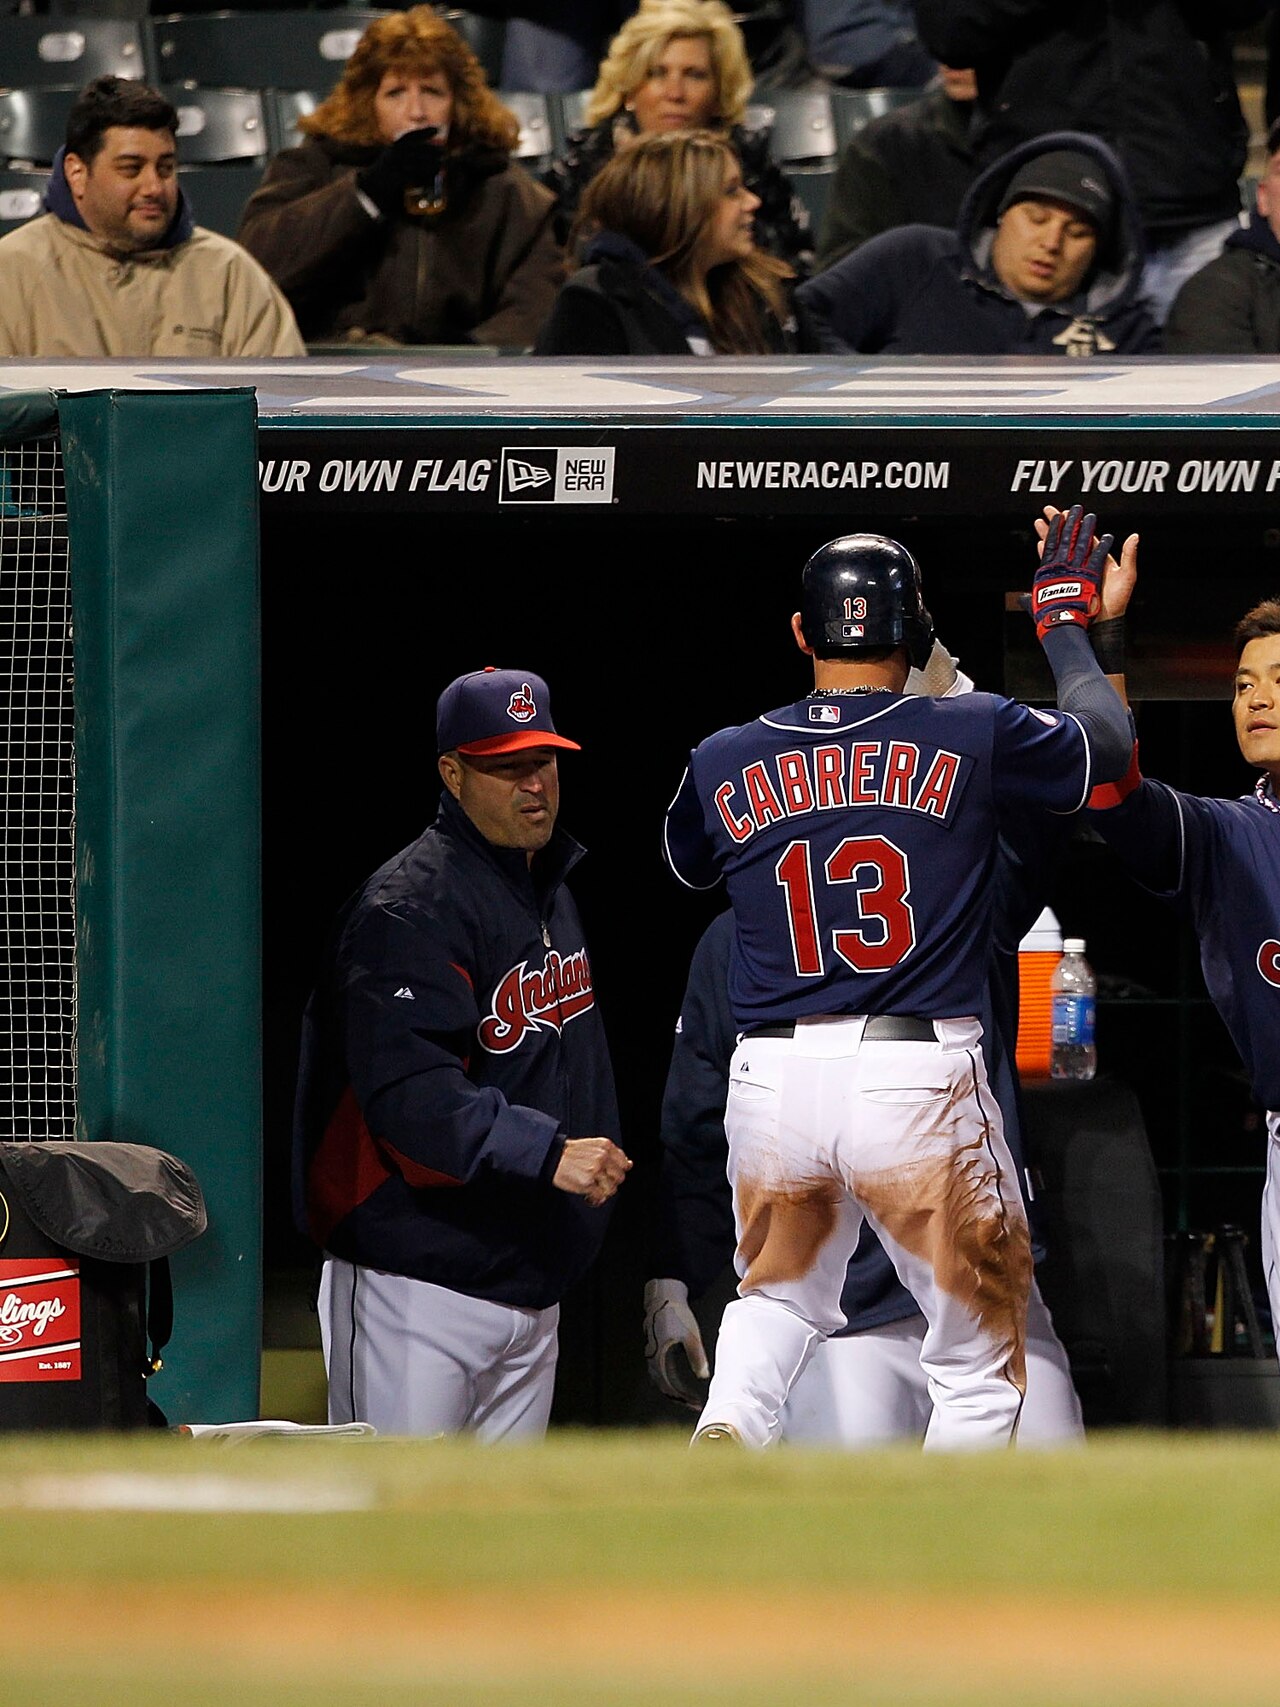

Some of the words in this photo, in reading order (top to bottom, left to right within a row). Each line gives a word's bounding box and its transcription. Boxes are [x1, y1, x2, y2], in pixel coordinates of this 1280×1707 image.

[259, 460, 310, 492] UR
[319, 459, 403, 492] OWN
[409, 460, 492, 492] FLAG
[564, 475, 605, 491] ERA
[565, 459, 606, 474] NEW
[697, 461, 949, 489] NEWERACAP.COM
[1010, 459, 1074, 492] FLY
[1081, 459, 1170, 492] YOUR
[1177, 459, 1261, 492] OWN
[843, 597, 867, 620] 13
[714, 740, 962, 843] CABRERA
[775, 834, 917, 977] 13
[0, 1293, 66, 1337] lings
